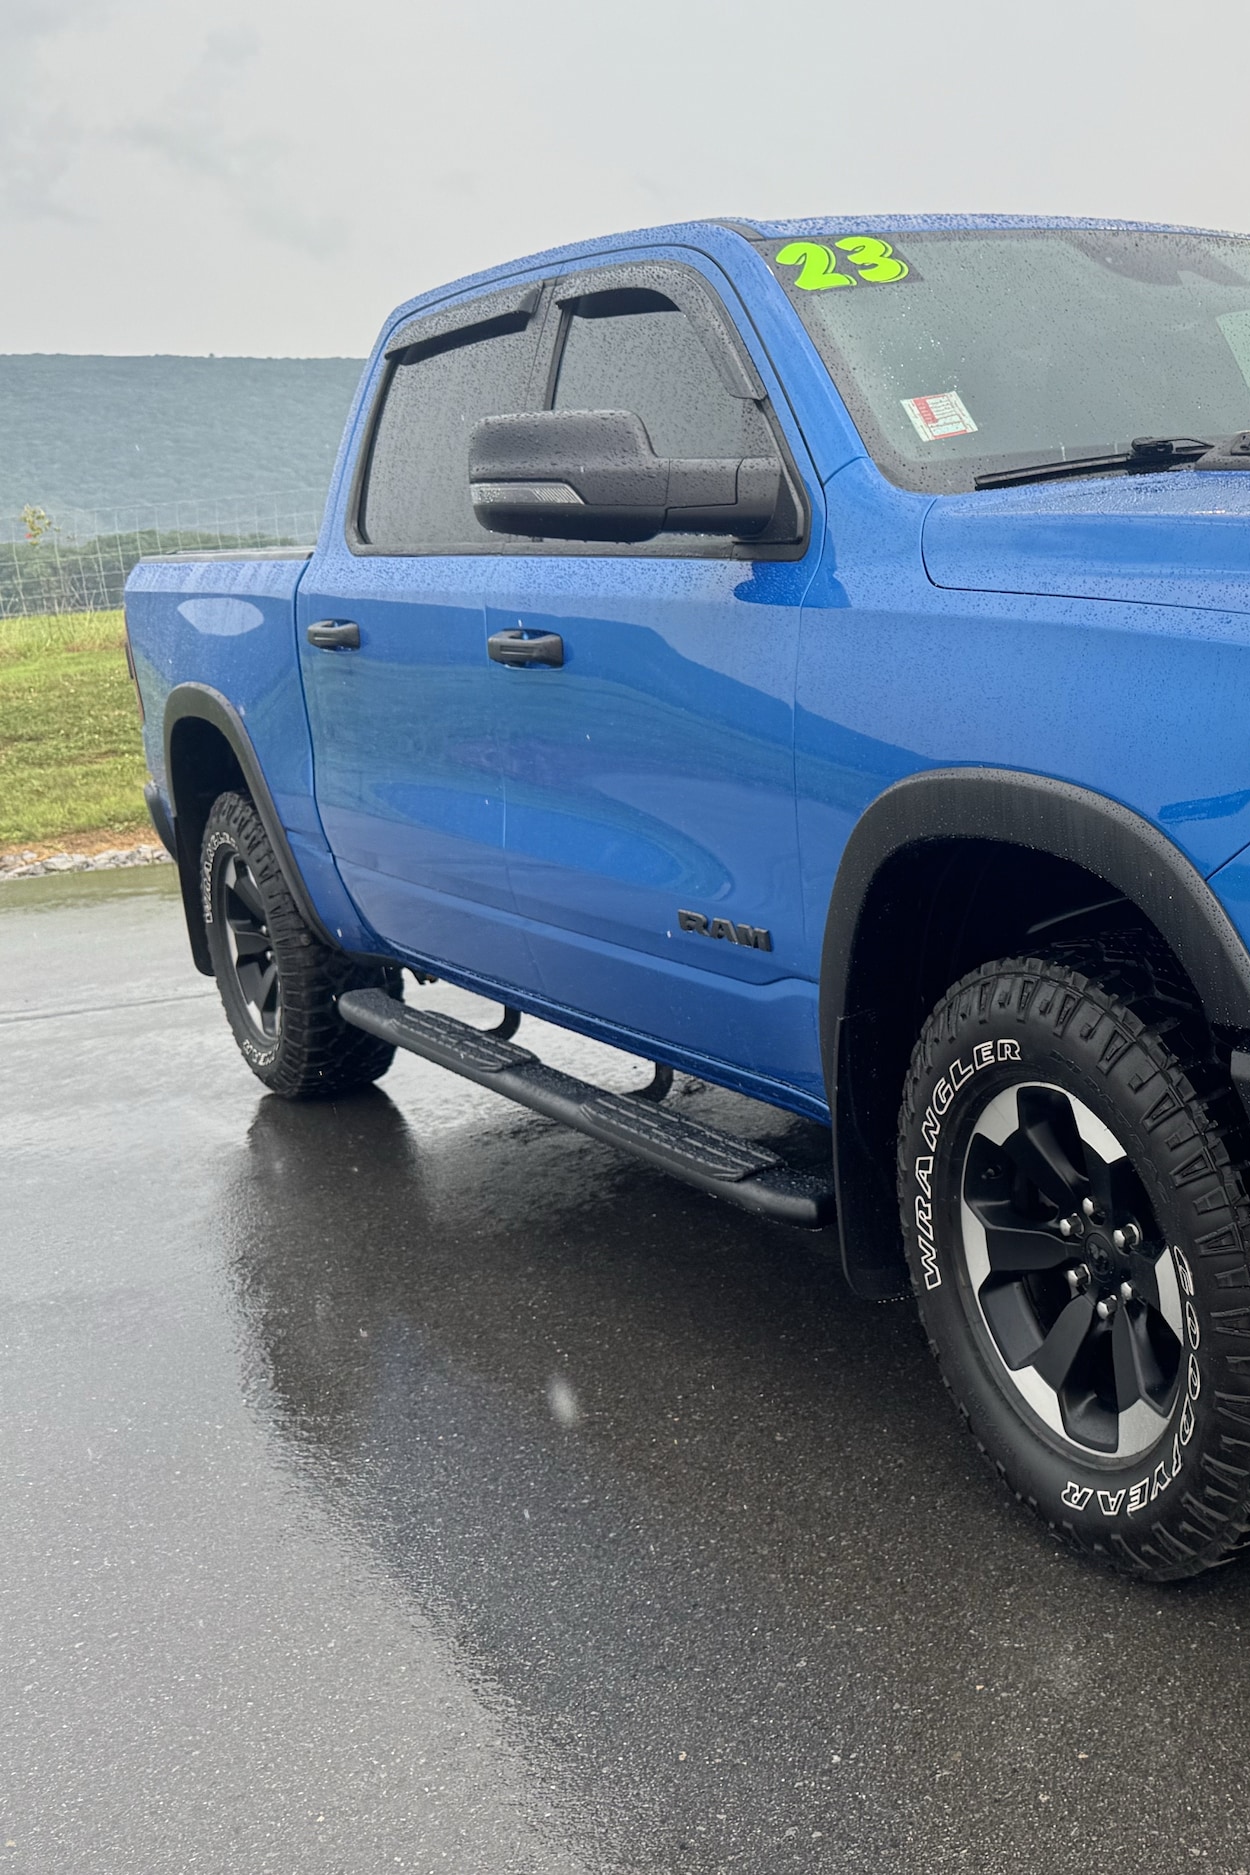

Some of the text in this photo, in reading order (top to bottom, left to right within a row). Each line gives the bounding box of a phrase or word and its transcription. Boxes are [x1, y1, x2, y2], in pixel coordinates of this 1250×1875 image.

[775, 236, 909, 290] 23
[678, 908, 773, 952] RAM
[914, 1038, 1022, 1291] WRANGLER
[1060, 1243, 1202, 1517] GOODYEAR
